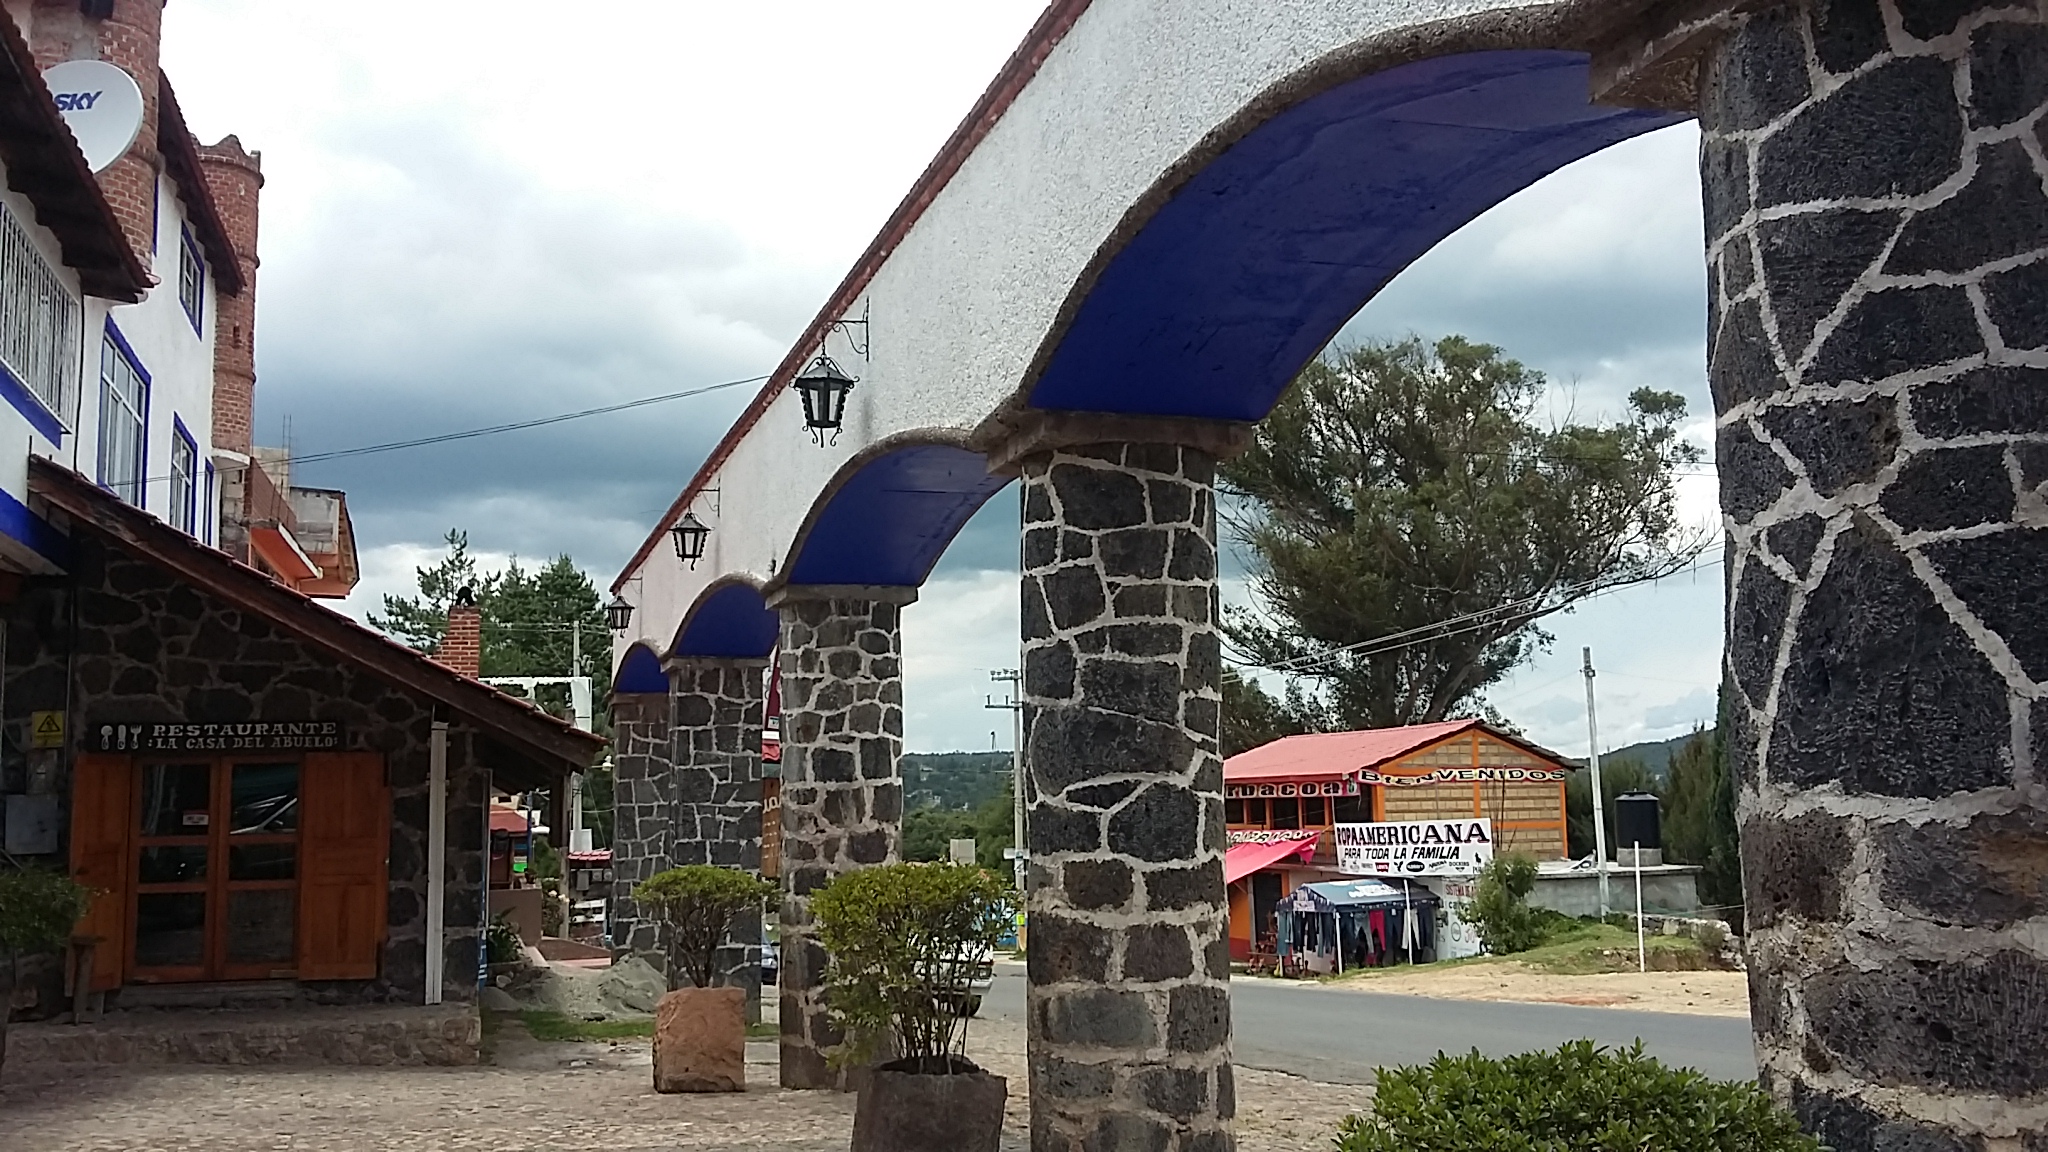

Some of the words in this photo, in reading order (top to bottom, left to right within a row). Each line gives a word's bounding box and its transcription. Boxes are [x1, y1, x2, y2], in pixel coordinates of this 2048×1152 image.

[54, 91, 103, 111] SKY
[153, 723, 336, 736] RESTAURANTE
[186, 738, 226, 749] CASA
[233, 737, 264, 748] DEL
[1361, 768, 1565, 785] BIENVENIDOS
[1344, 848, 1361, 859] PARA
[1365, 848, 1389, 860] TODA
[1394, 847, 1407, 860] LA
[1411, 846, 1460, 859] FAMILIA
